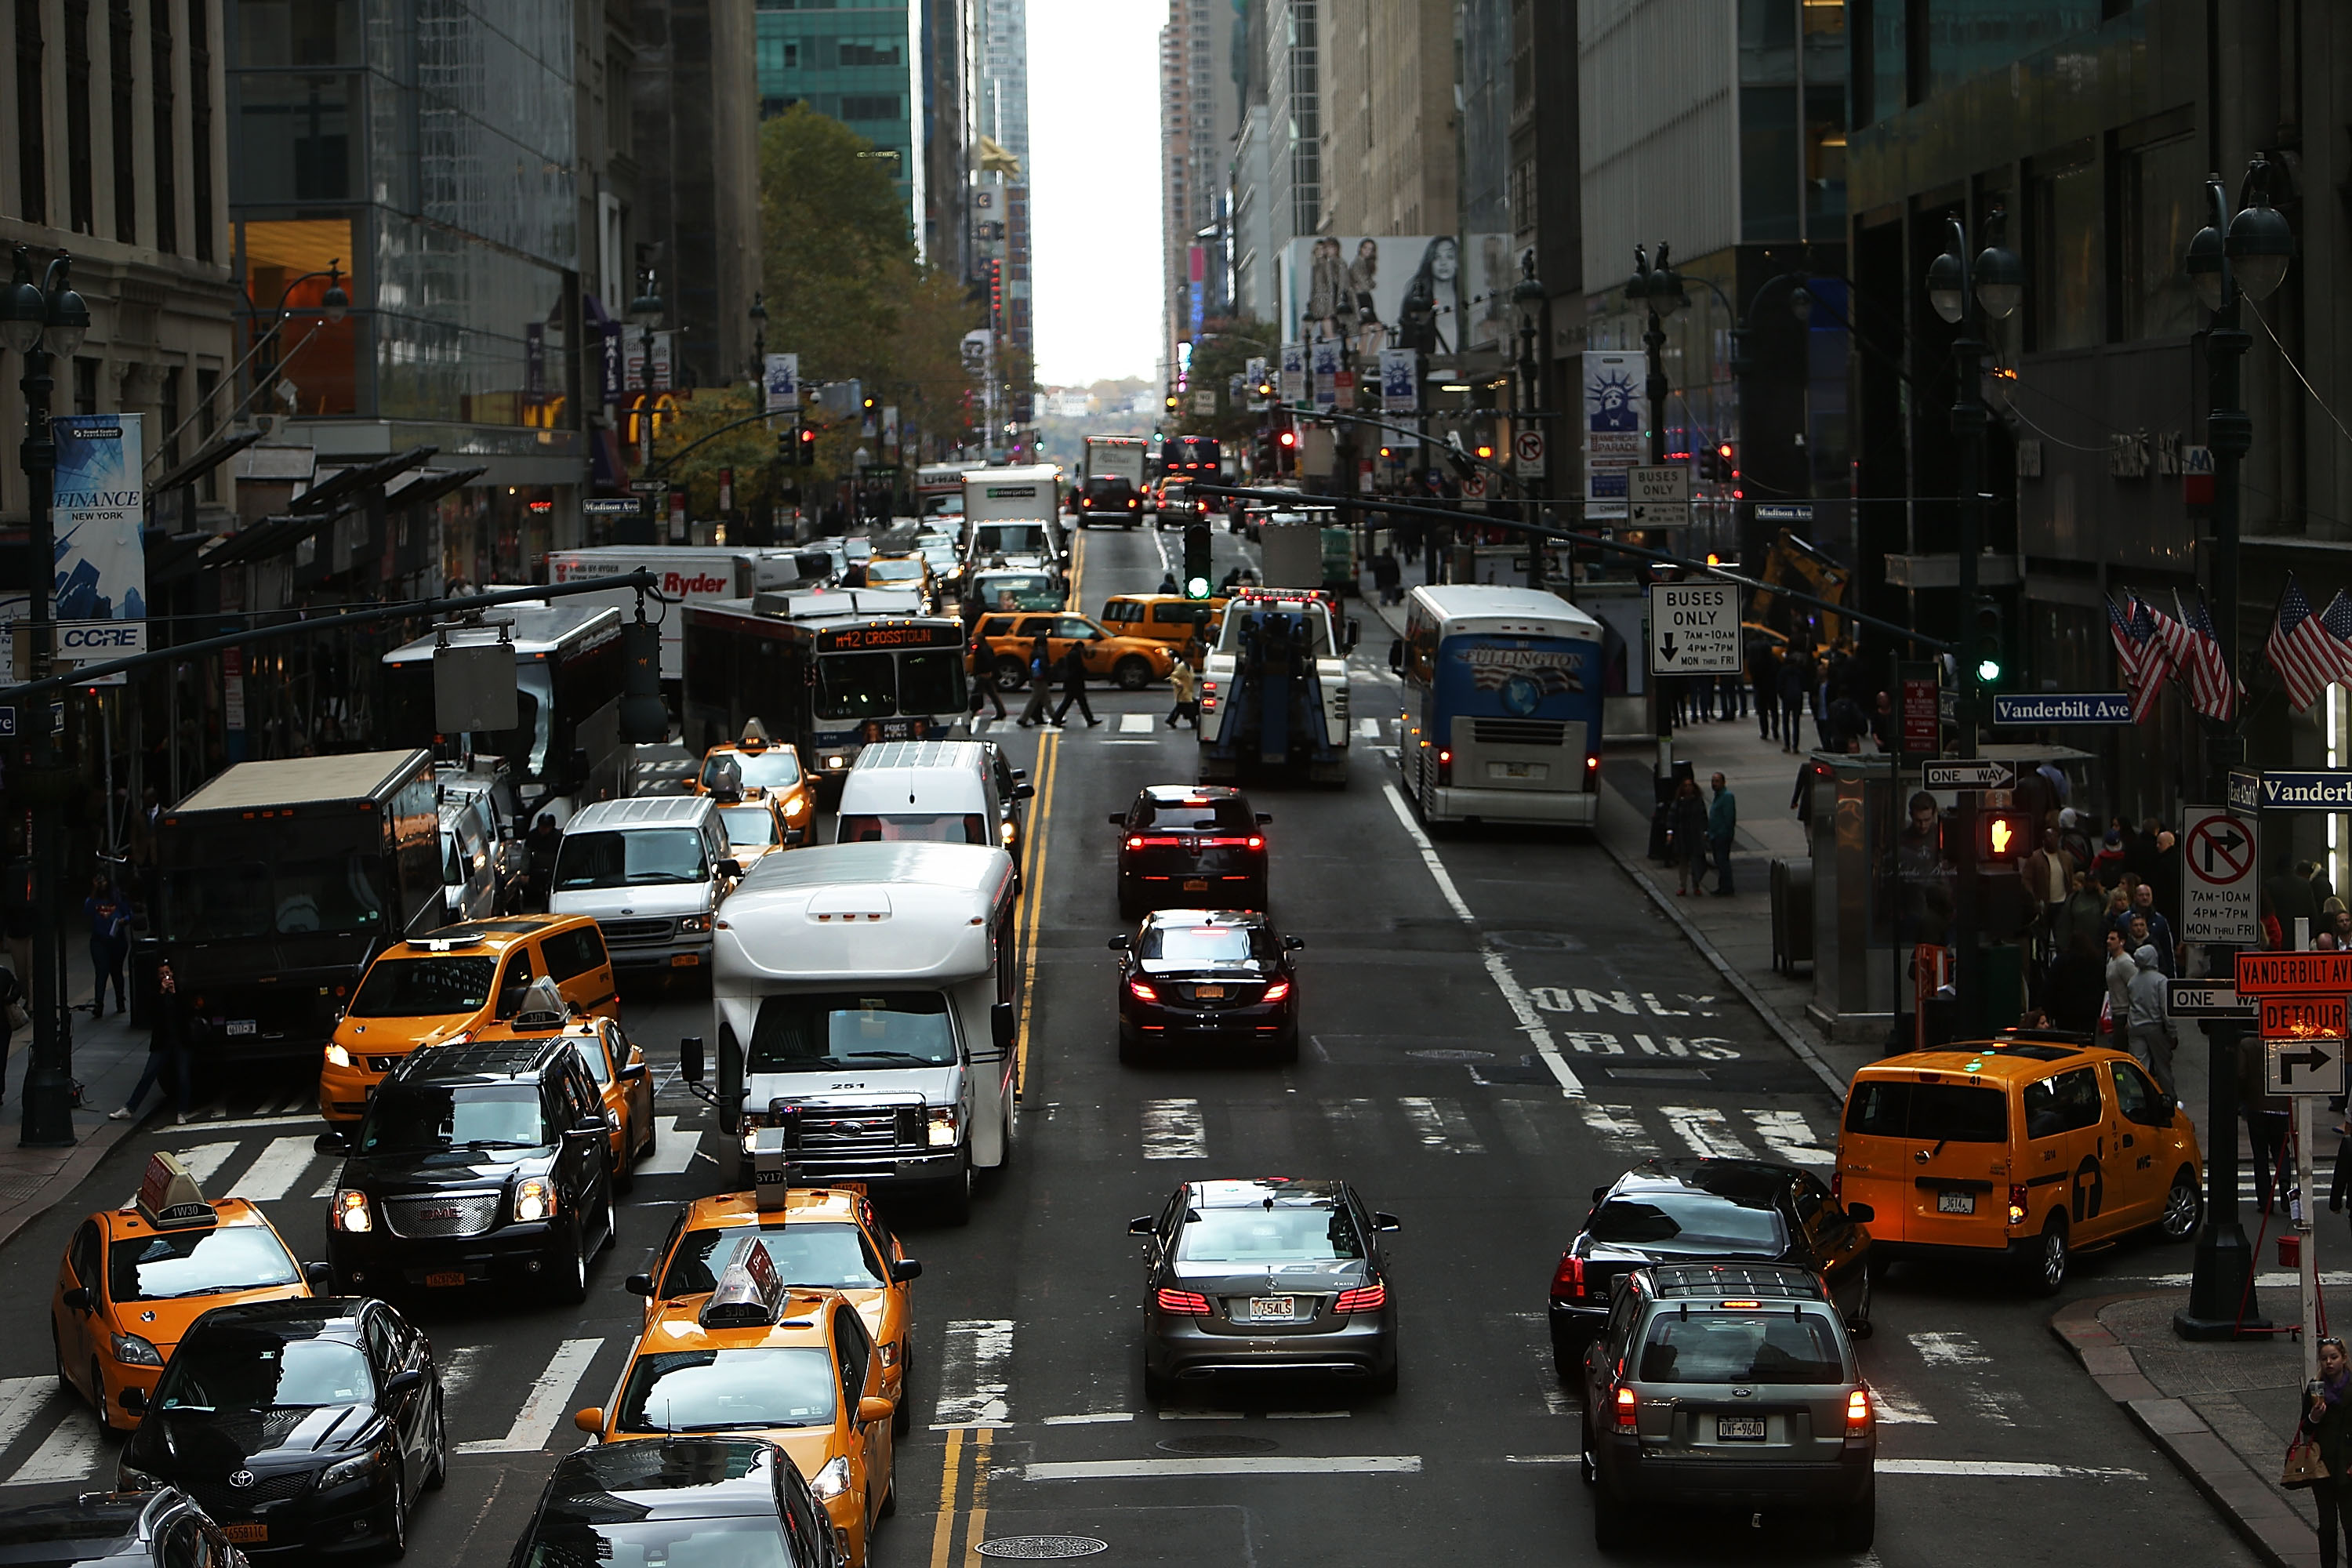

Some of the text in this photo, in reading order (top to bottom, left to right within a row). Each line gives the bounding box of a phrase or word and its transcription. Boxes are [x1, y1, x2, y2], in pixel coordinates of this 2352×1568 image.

[1599, 443, 1638, 452] PARADE
[1638, 471, 1678, 481] BUSES
[1643, 485, 1673, 495] ONLY
[55, 491, 140, 508] FINANCE
[585, 502, 619, 511] Madison
[1757, 507, 1793, 517] Madison
[71, 512, 123, 521] NEW YORK
[663, 572, 727, 596] Ryder
[1667, 592, 1723, 606] BUSES
[1674, 612, 1716, 625] ONLY
[64, 629, 137, 647] CCRE
[865, 628, 931, 645] CROSSTOWN
[1465, 649, 1584, 666] FULLINGTON
[1721, 655, 1734, 665] FRI
[1998, 701, 2129, 719] Vanderbilt Ave
[1932, 770, 2004, 781] ONE WAY
[2186, 924, 2210, 935] MON
[2238, 925, 2255, 935] FRI
[2242, 960, 2352, 985] VANDERBILT AV
[1529, 986, 1721, 1017] ONLY
[2177, 992, 2259, 1006] ONE WA
[2267, 1005, 2343, 1029] DETOUR
[1564, 1031, 1741, 1060] BUS
[1969, 1076, 1980, 1085] 41
[756, 1172, 782, 1184] 5Y17
[172, 1205, 198, 1218] 1W30
[420, 1208, 463, 1220] GMC
